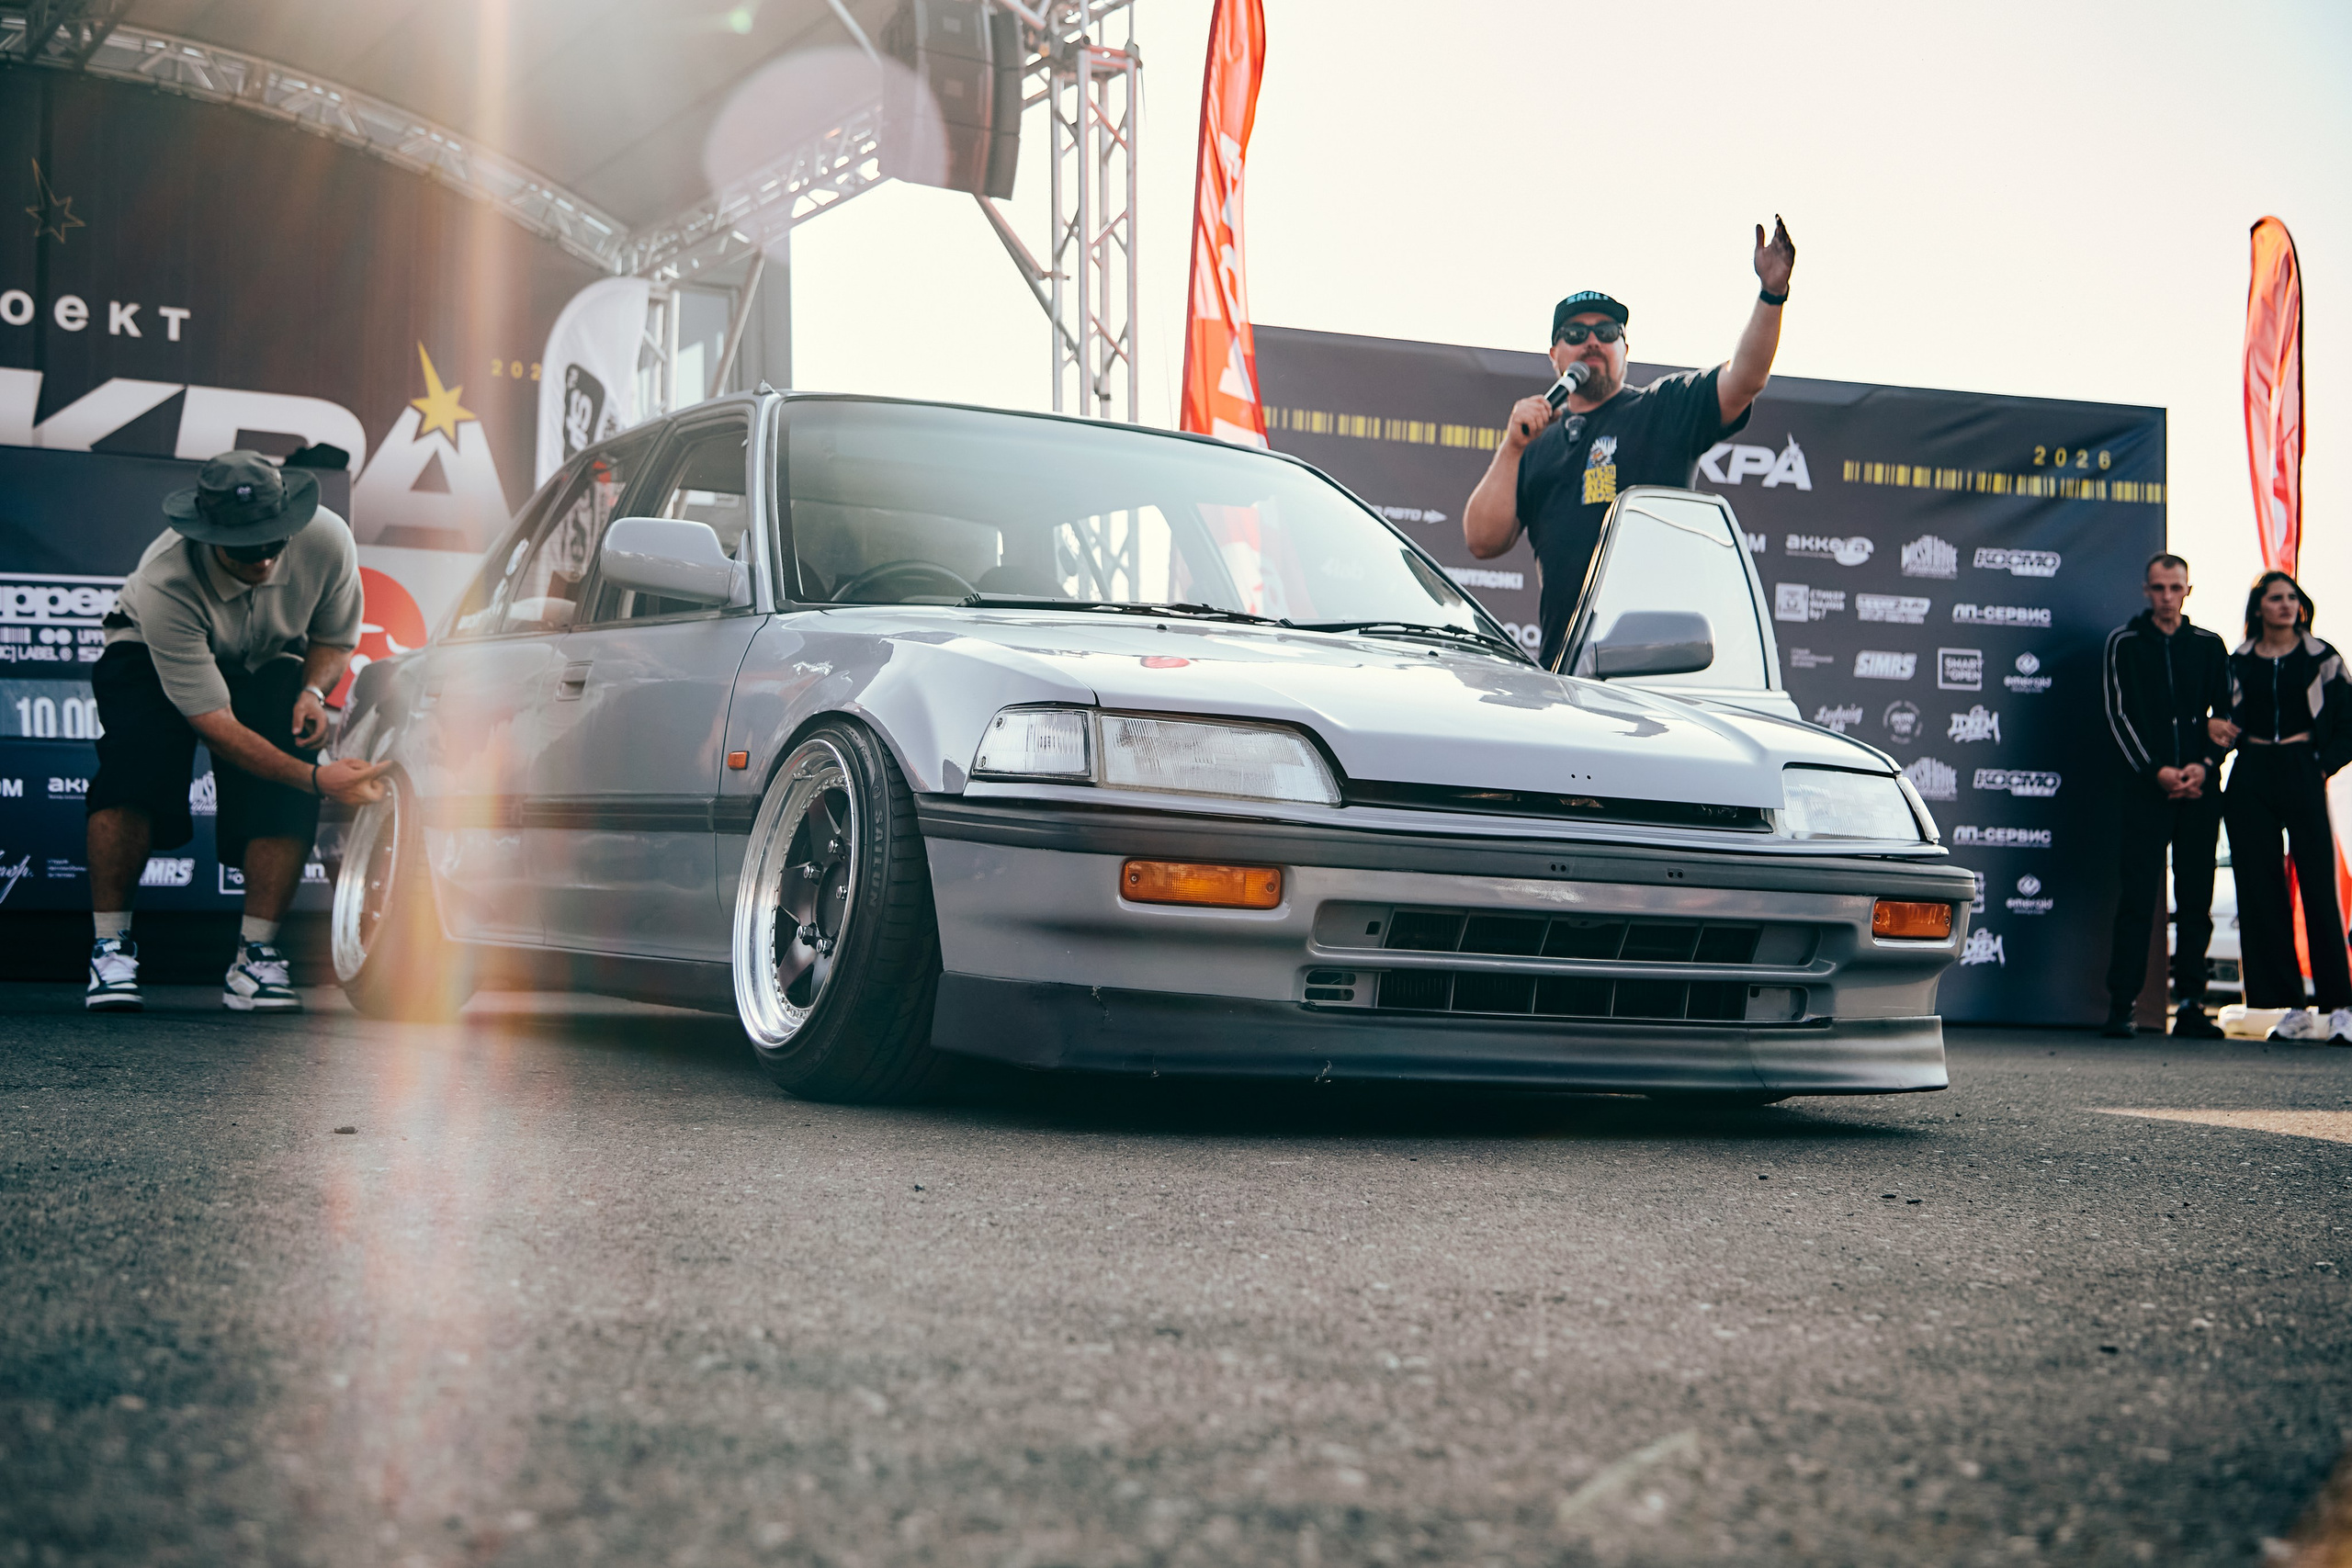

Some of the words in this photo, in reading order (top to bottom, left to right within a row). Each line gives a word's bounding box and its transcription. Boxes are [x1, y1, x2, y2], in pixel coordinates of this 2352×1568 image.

[2032, 445, 2112, 471] 2026
[0, 586, 121, 618] pper
[868, 808, 884, 908] SAILUN
